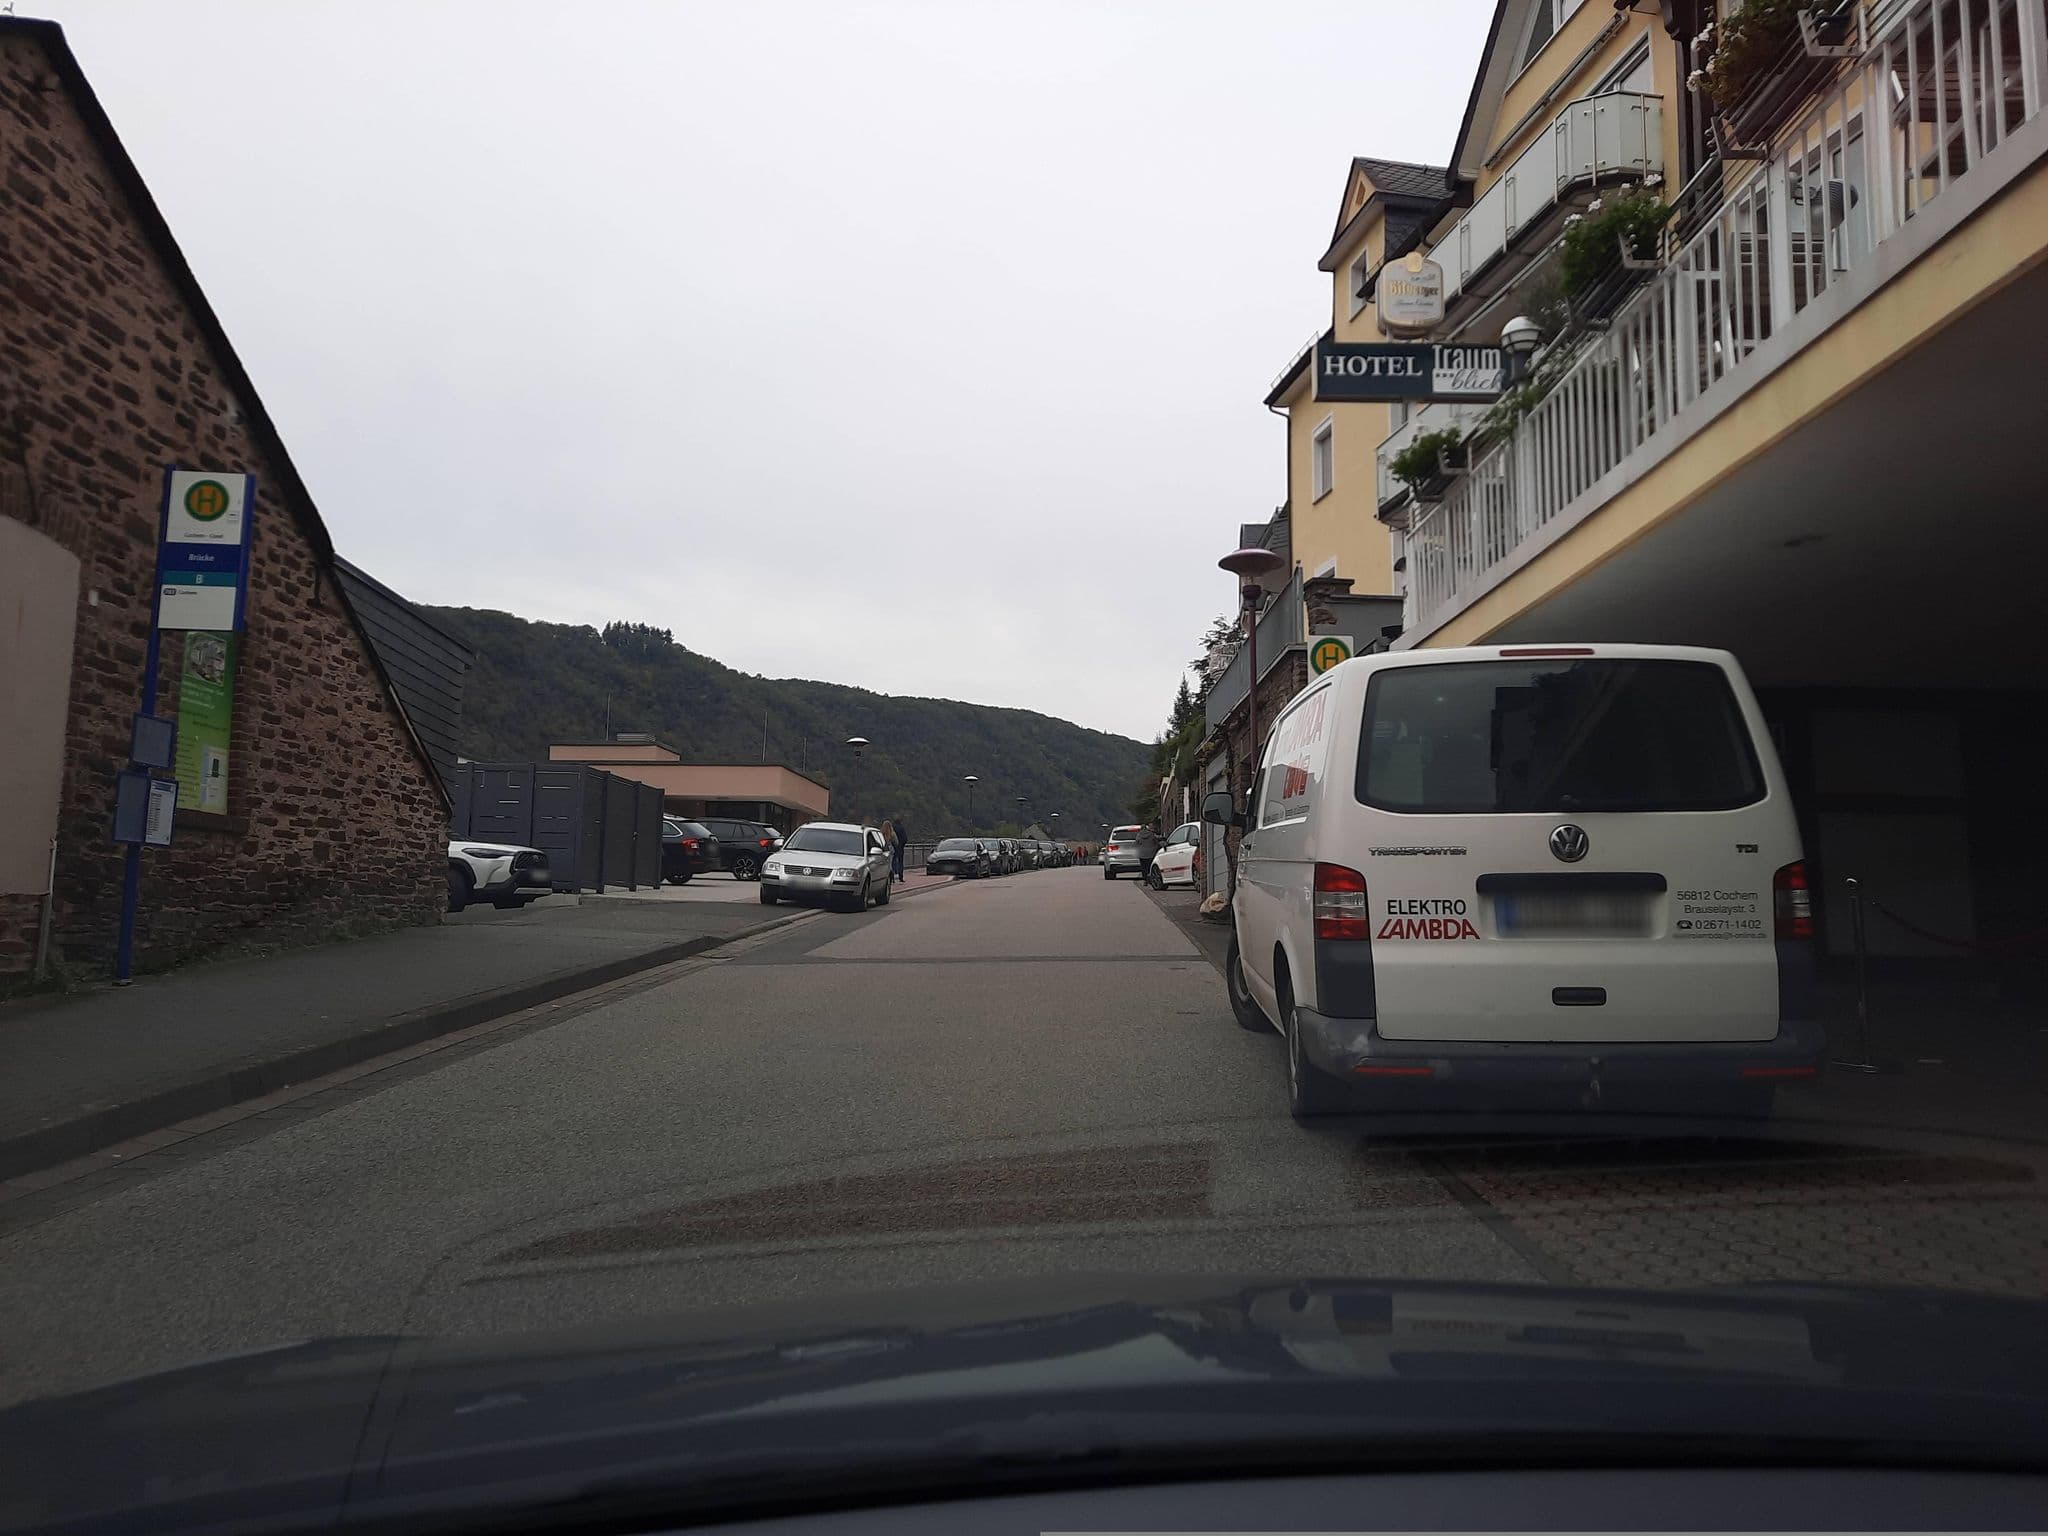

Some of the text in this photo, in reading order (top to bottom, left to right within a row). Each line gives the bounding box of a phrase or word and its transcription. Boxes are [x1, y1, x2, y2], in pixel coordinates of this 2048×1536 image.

[1432, 344, 1500, 370] Traum
[1324, 355, 1423, 377] HOTEL
[1451, 368, 1505, 391] blick
[188, 553, 215, 562] Brücke
[1368, 845, 1468, 857] TRANSPORTER
[1677, 890, 1759, 901] 56812 Cochem
[1387, 899, 1467, 915] ELEKTRO
[1684, 904, 1756, 916] Brauselaystr. 3
[1376, 918, 1481, 940] LAMBDA
[1694, 919, 1762, 930] 02671-1402
